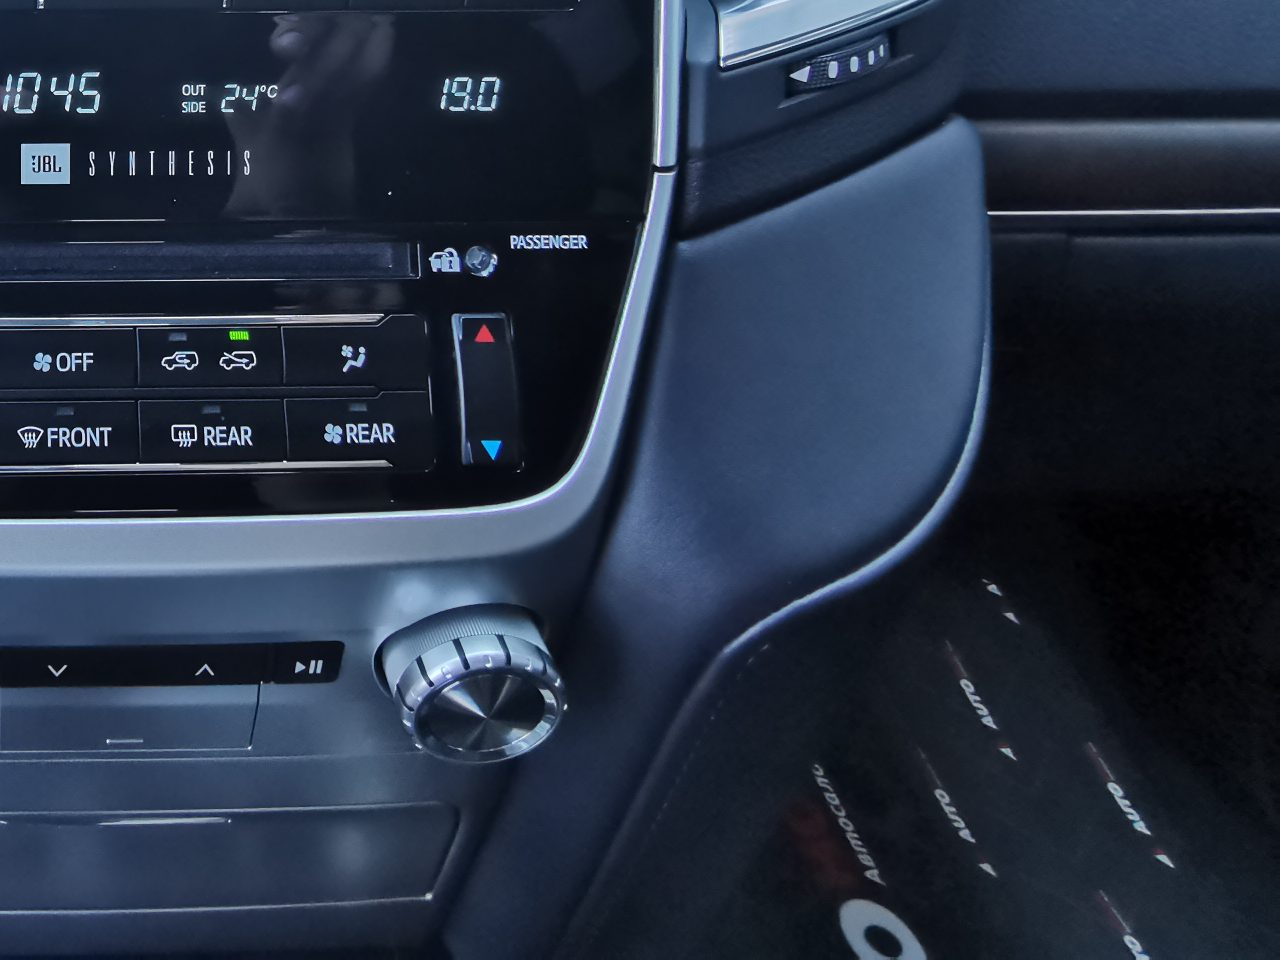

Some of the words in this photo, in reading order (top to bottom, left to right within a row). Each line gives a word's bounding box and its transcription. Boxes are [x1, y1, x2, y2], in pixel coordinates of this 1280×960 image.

[181, 84, 206, 97] OUT
[440, 76, 501, 112] 19.0
[181, 102, 206, 114] SIDE
[31, 155, 62, 173] JBL
[88, 150, 251, 177] SYNTHESIS
[509, 234, 589, 251] PASSENGER
[55, 352, 95, 372] OFF
[46, 426, 112, 448] FRONT
[202, 426, 253, 447] REAR
[345, 422, 396, 444] REAR
